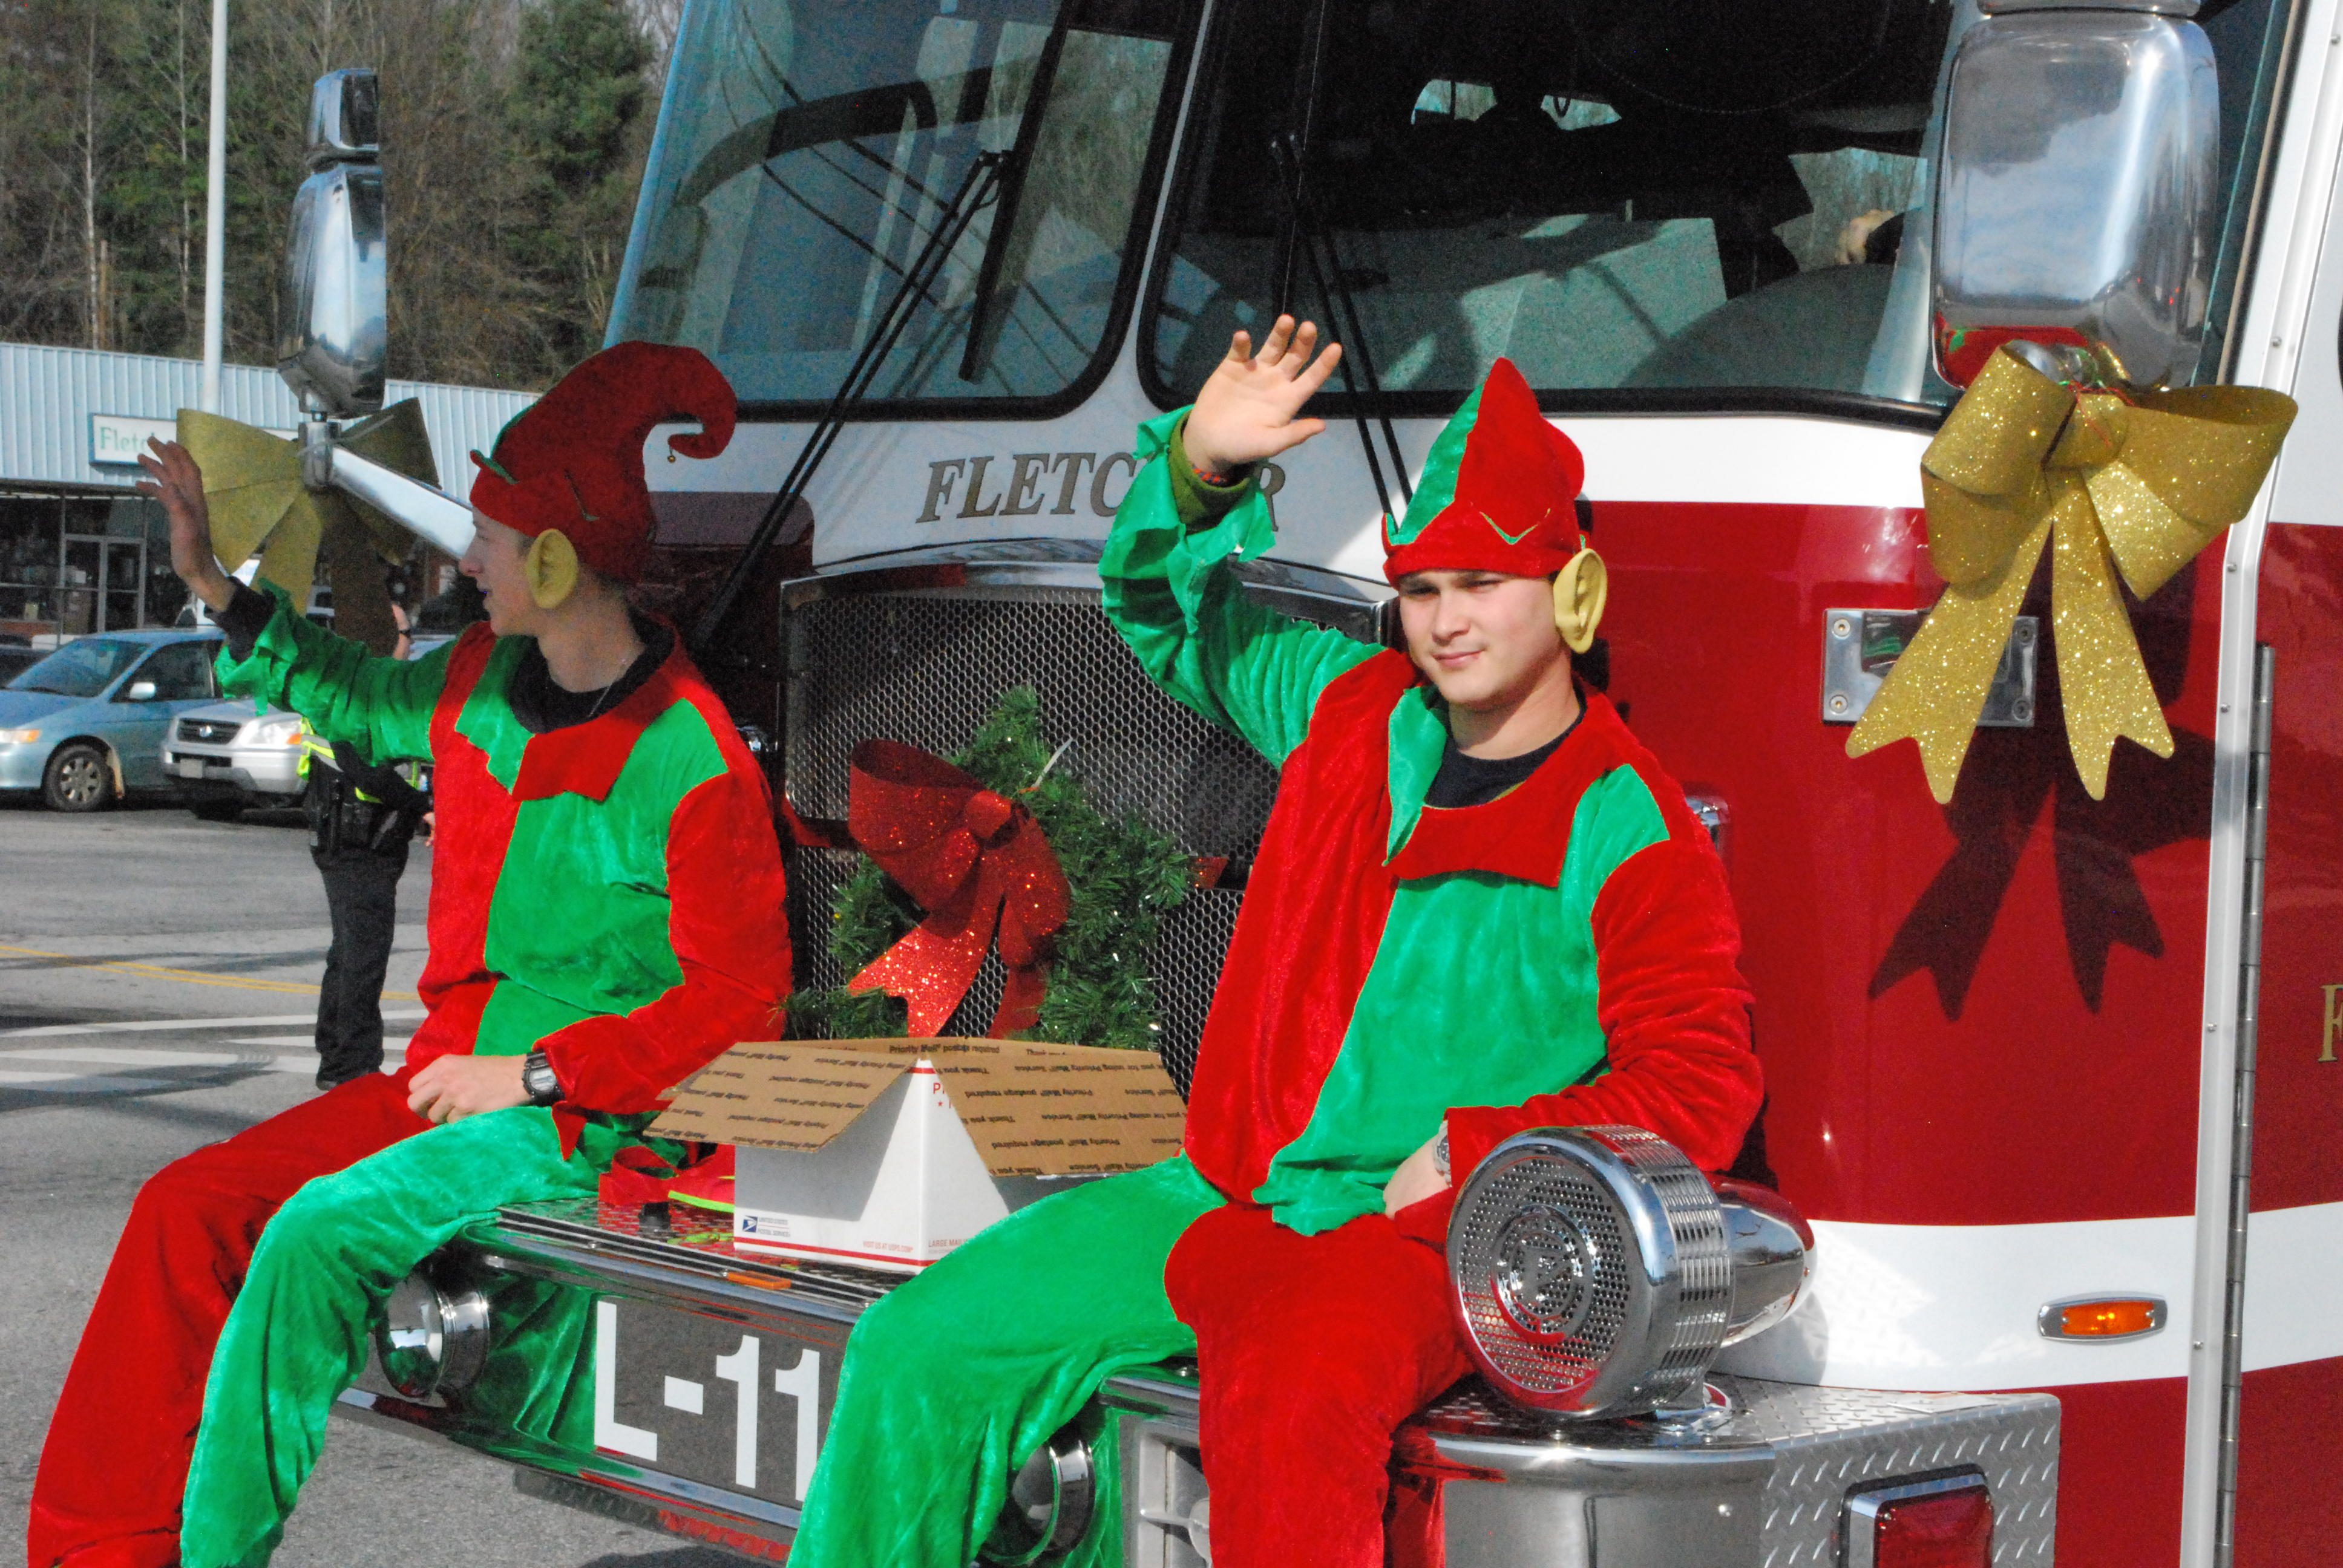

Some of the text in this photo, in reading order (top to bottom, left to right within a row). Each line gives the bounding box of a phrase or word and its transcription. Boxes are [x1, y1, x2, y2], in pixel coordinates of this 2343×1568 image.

[100, 426, 155, 452] Fletc
[916, 452, 1286, 532] FLETCR
[594, 1301, 820, 1502] L-11
